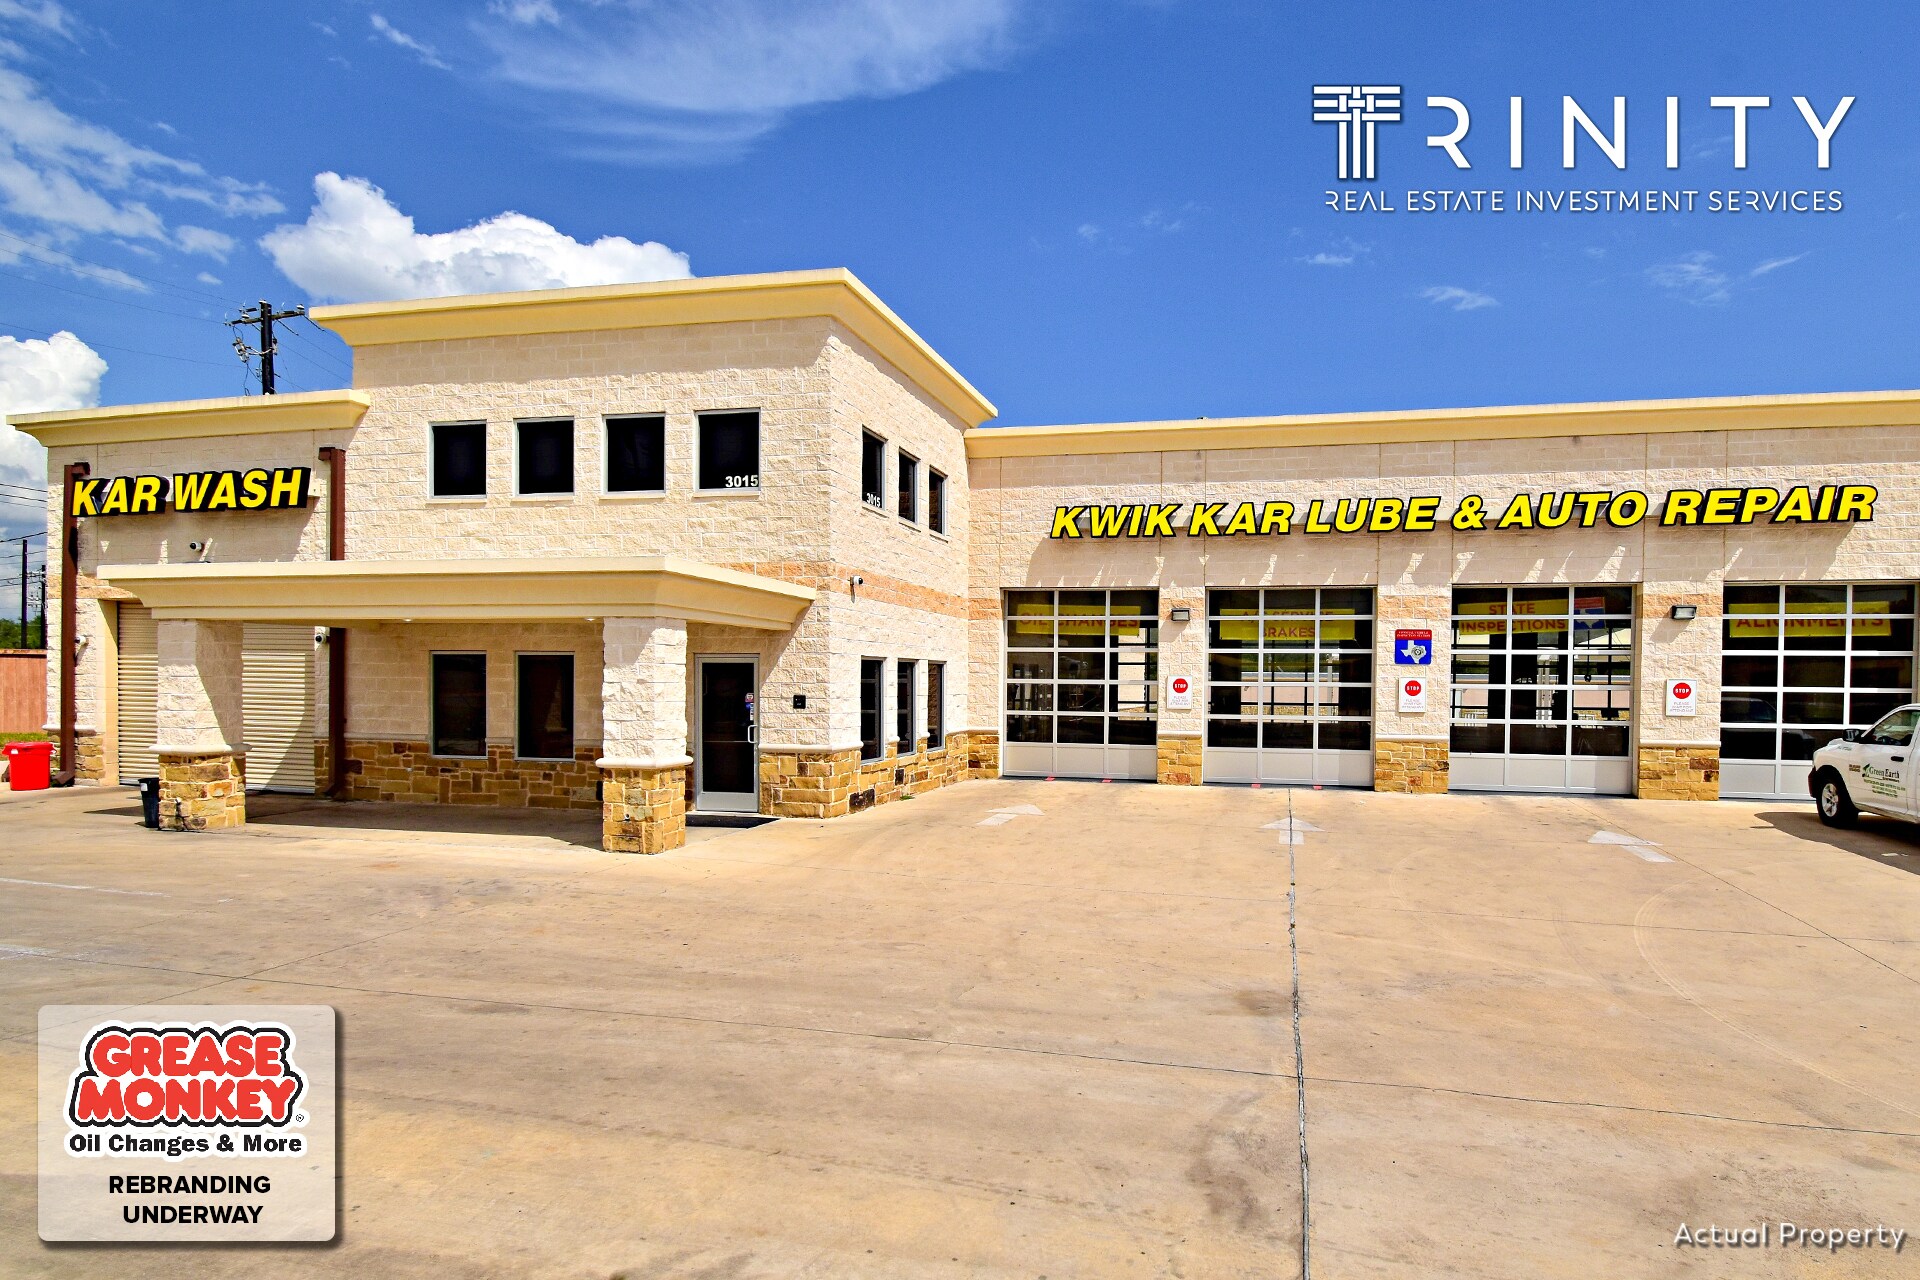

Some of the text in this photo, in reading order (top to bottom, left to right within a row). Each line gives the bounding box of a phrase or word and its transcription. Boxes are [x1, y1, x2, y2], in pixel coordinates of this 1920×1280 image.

[725, 475, 759, 488] 3015
[71, 467, 311, 517] KAR WASH
[866, 492, 881, 508] 3015
[1050, 485, 1877, 538] KWIK KAR LUBE & AUTO REPAIR
[1020, 612, 1048, 626] OIL
[1869, 766, 1884, 776] Green
[1885, 768, 1900, 779] Earth
